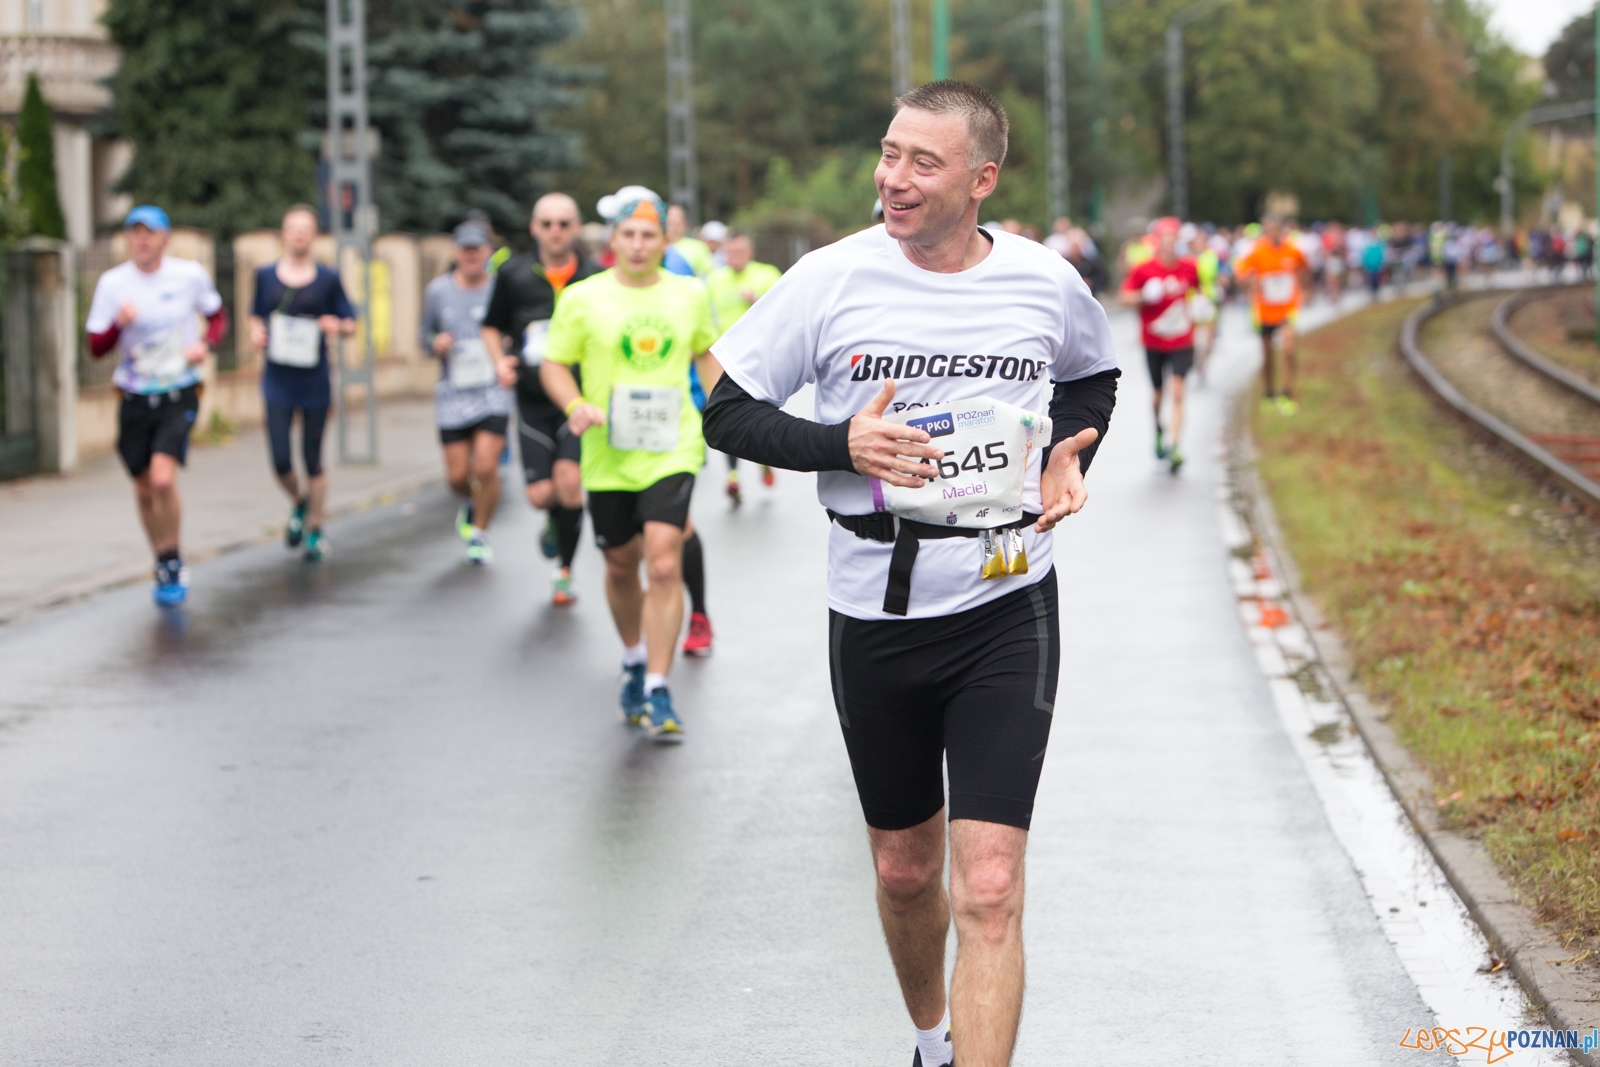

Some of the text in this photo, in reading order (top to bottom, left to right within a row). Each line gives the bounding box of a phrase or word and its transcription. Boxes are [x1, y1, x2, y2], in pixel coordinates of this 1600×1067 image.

[851, 354, 1046, 381] BRIDGESTONE
[927, 419, 951, 432] PKO
[958, 415, 996, 428] maraton
[942, 481, 988, 499] Maciej
